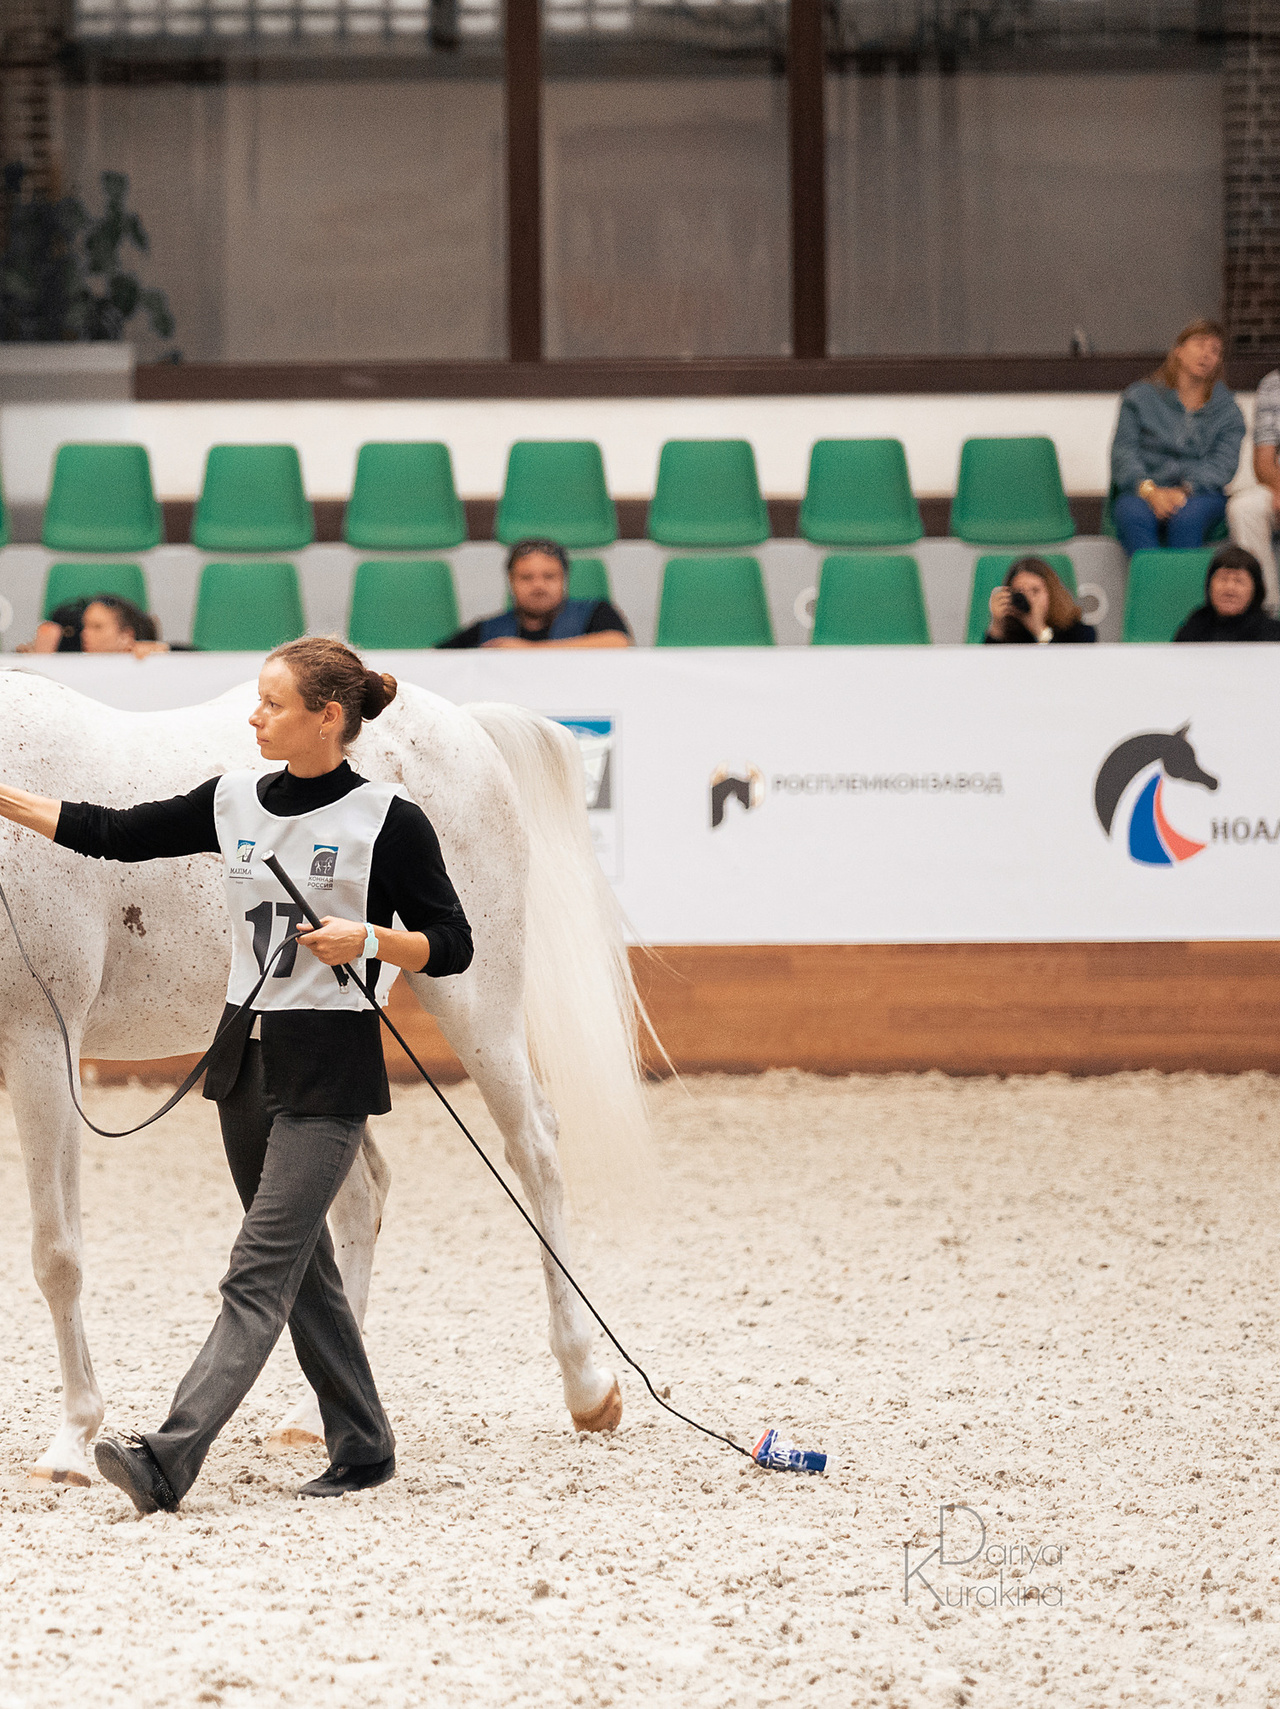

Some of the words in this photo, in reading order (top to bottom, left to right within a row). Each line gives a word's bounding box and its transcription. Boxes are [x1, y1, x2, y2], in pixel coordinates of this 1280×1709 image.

[772, 772, 1005, 796] РОСПЛЕМКОНЗАВОД
[230, 867, 252, 875] MAXIMA
[245, 901, 303, 977] 17
